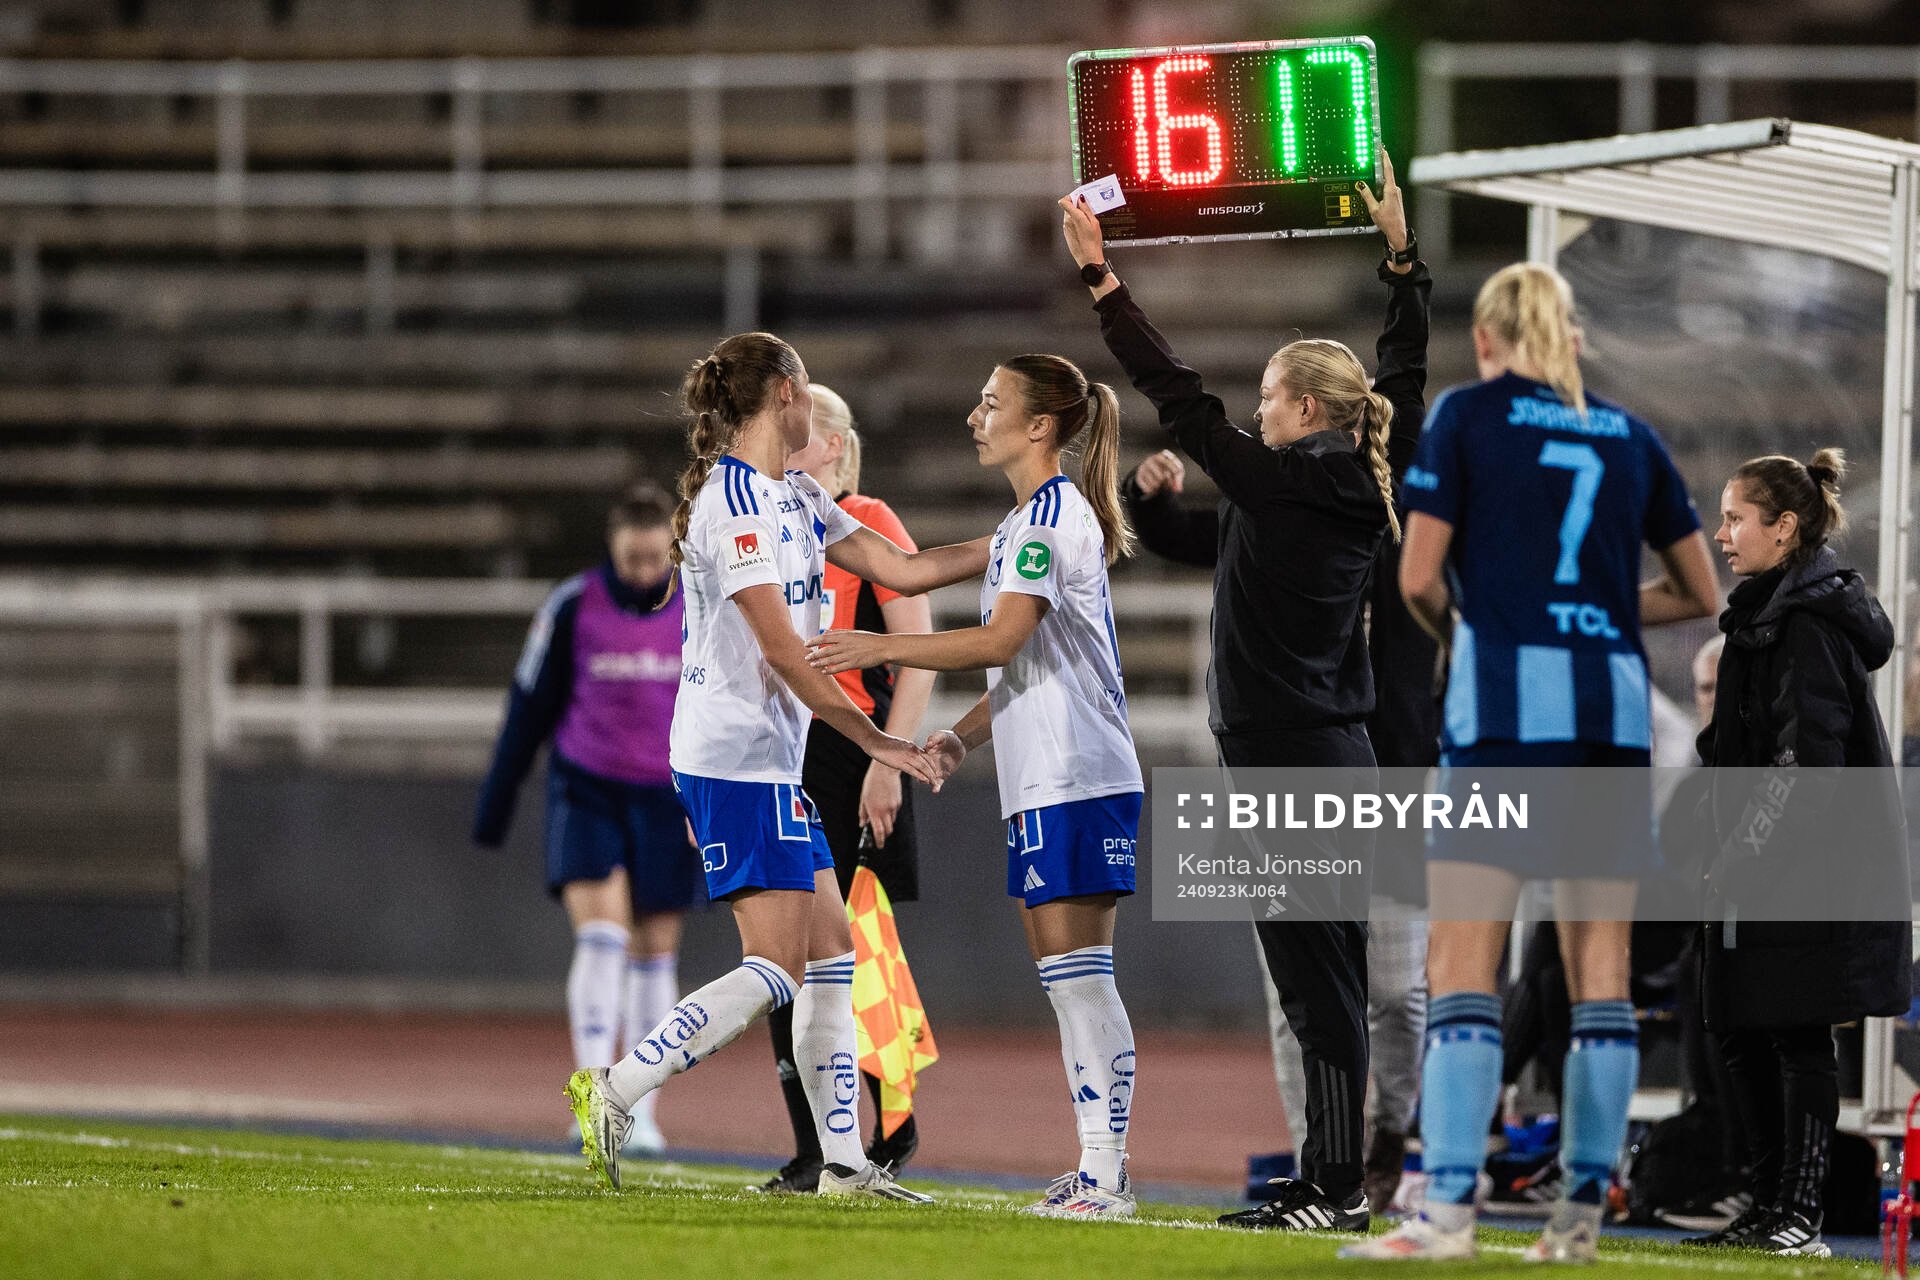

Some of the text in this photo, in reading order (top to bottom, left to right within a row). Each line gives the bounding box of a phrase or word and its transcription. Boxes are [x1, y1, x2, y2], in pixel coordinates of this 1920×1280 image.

[1131, 54, 1222, 185] 16
[1278, 49, 1368, 173] 17
[1198, 204, 1258, 216] UNISPORT
[1538, 439, 1606, 586] 7
[729, 558, 758, 571] SVENSKA
[1546, 602, 1621, 640] TCL
[1105, 854, 1136, 867] zero
[633, 1001, 709, 1066] Ocab
[816, 1050, 855, 1134] Ocab
